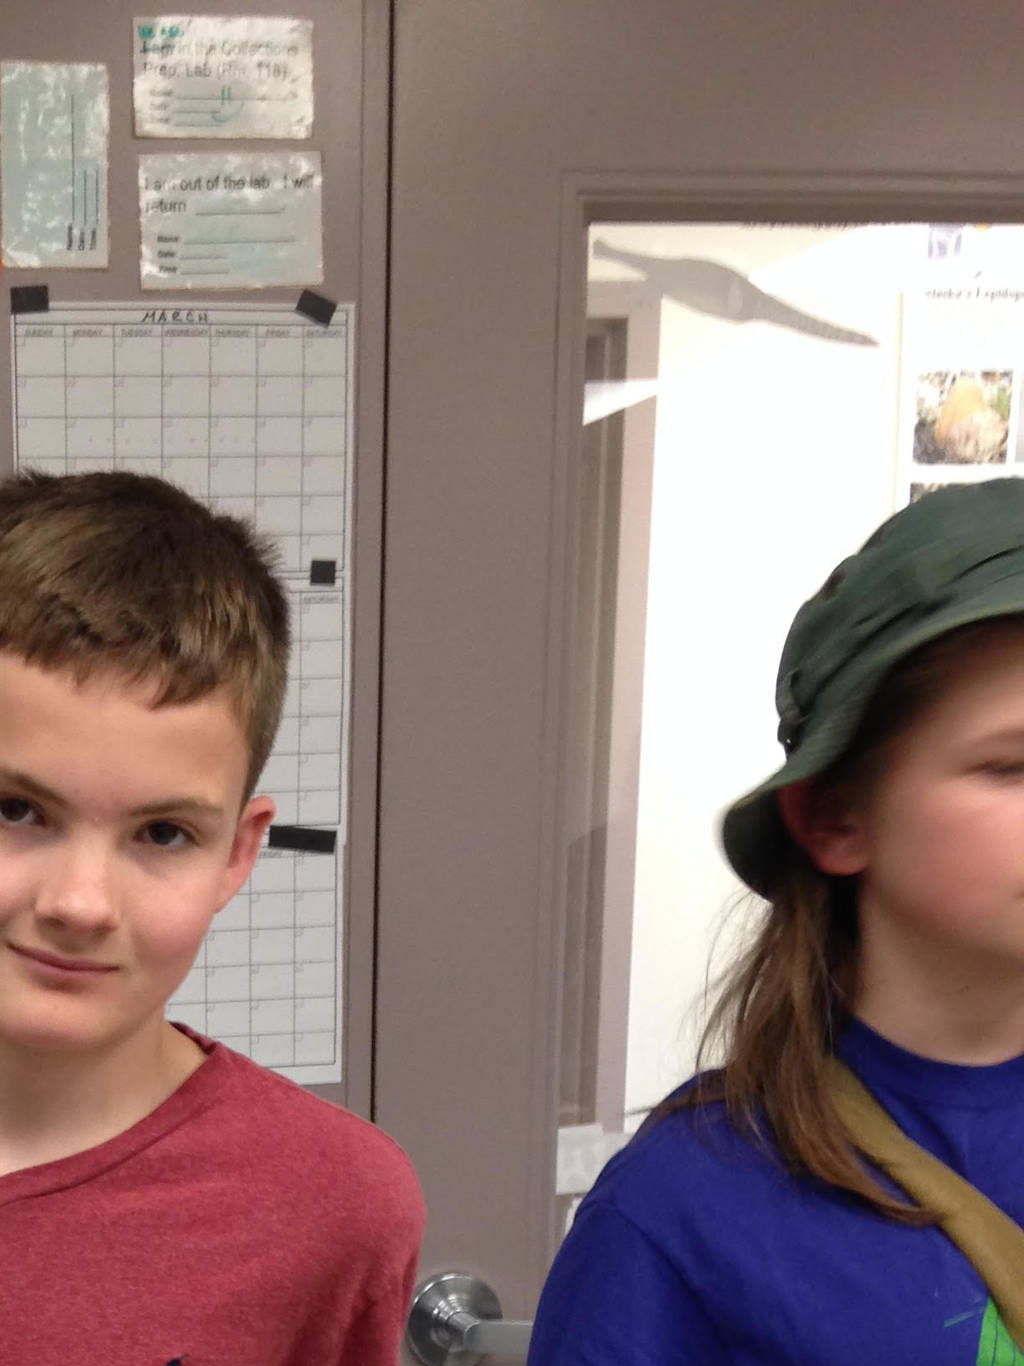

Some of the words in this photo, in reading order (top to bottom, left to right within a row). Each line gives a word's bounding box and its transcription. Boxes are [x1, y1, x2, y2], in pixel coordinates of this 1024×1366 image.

[180, 178, 202, 191] out
[206, 176, 220, 190] of
[224, 176, 246, 190] the
[145, 199, 187, 214] return
[140, 310, 209, 324] MARCH
